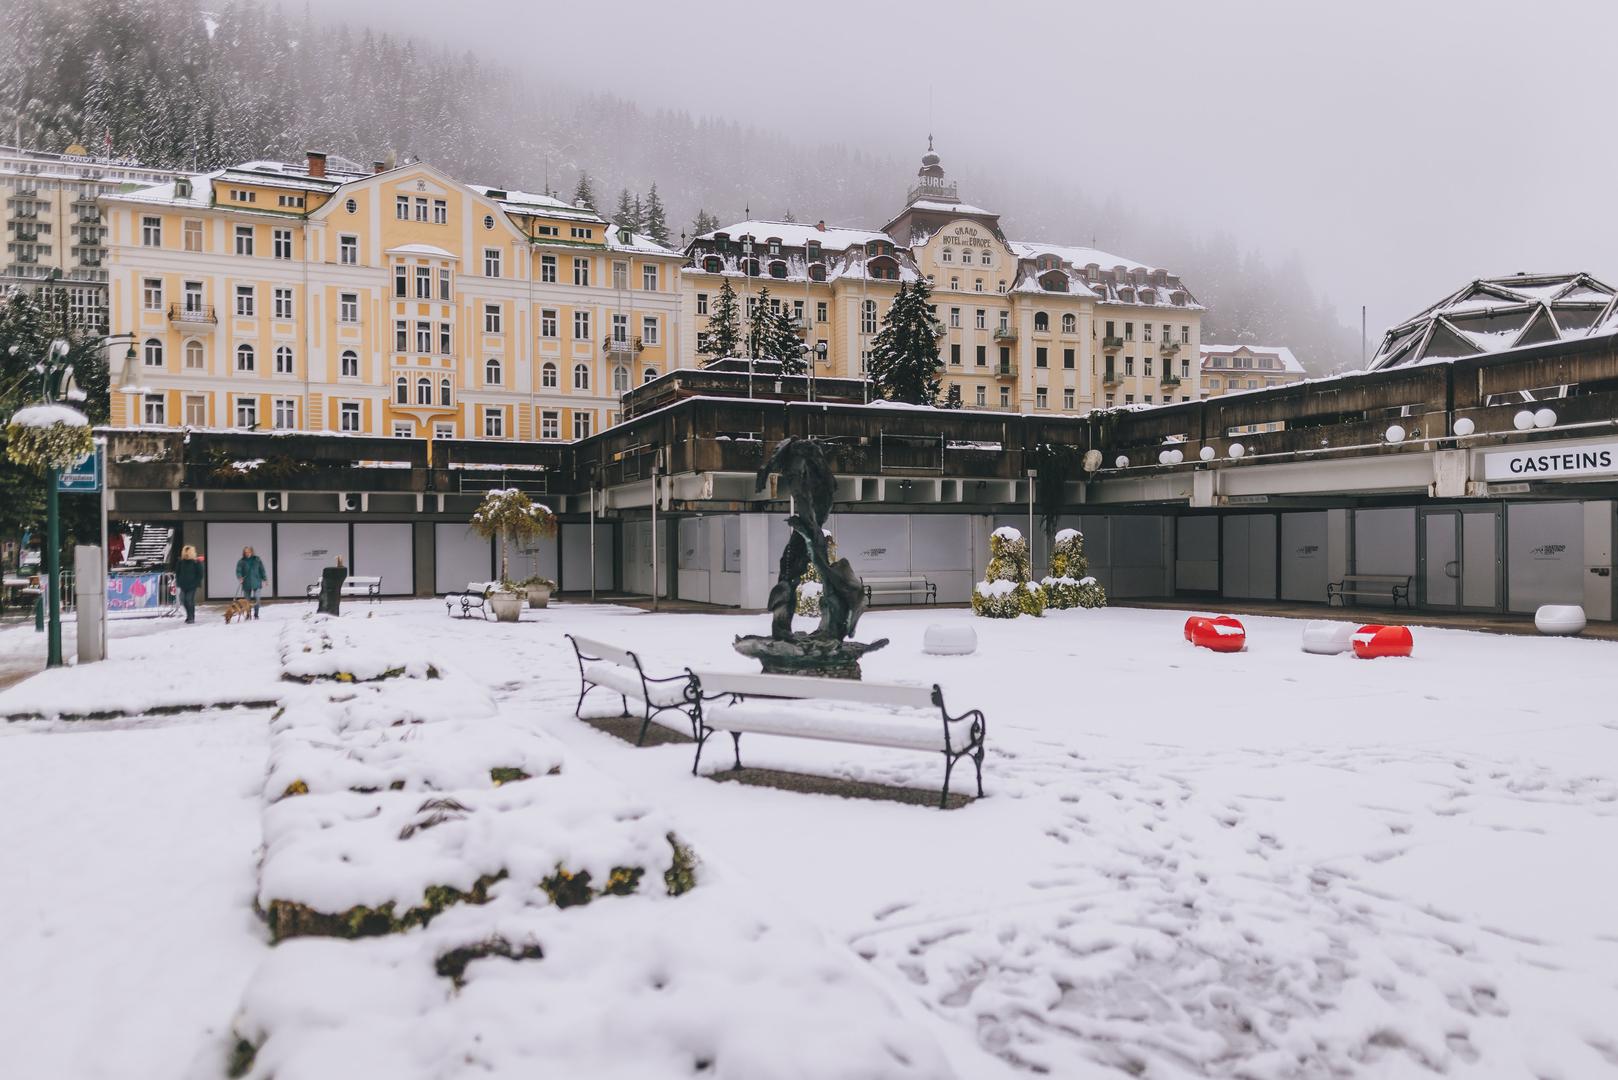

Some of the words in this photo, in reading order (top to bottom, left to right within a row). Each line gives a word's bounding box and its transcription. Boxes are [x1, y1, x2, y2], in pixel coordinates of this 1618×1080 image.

[954, 227, 978, 237] GRAND
[942, 235, 961, 246] HOTEL
[969, 237, 992, 248] EUROPE
[1509, 451, 1612, 474] GASTEINS
